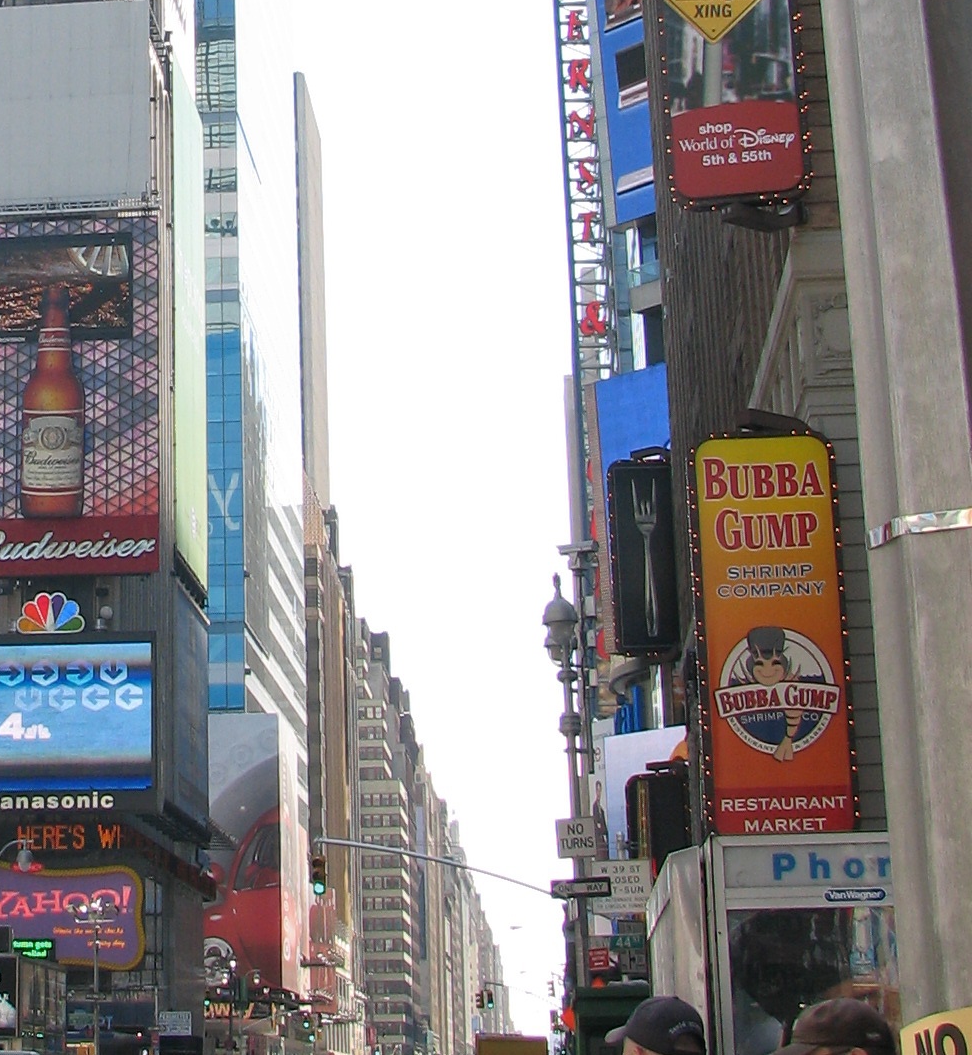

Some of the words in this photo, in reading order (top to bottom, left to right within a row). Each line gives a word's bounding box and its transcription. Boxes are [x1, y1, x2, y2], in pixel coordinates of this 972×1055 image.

[694, 4, 732, 19] XING
[699, 122, 732, 134] shop
[678, 137, 717, 152] World
[720, 135, 735, 149] of
[702, 154, 725, 166] 5th
[728, 152, 738, 164] &
[741, 149, 772, 163] 55th
[702, 456, 825, 502] BUBBA
[714, 507, 818, 552] GUMP
[727, 563, 813, 580] SHRIMP
[716, 581, 826, 598] COMPANY
[720, 688, 781, 714] BUBBA
[784, 683, 837, 710] GUMP
[740, 711, 784, 724] SHRIMP
[802, 712, 820, 722] CO
[728, 716, 774, 752] RESTAURANT
[721, 795, 847, 812] RESTAURANT
[567, 823, 584, 835] NO
[744, 817, 827, 833] MARKET
[18, 824, 85, 850] HERE'S
[560, 837, 595, 850] TURNS
[612, 866, 625, 874] 39
[629, 865, 641, 873] ST
[587, 882, 604, 891] WAY
[615, 937, 630, 946] 44
